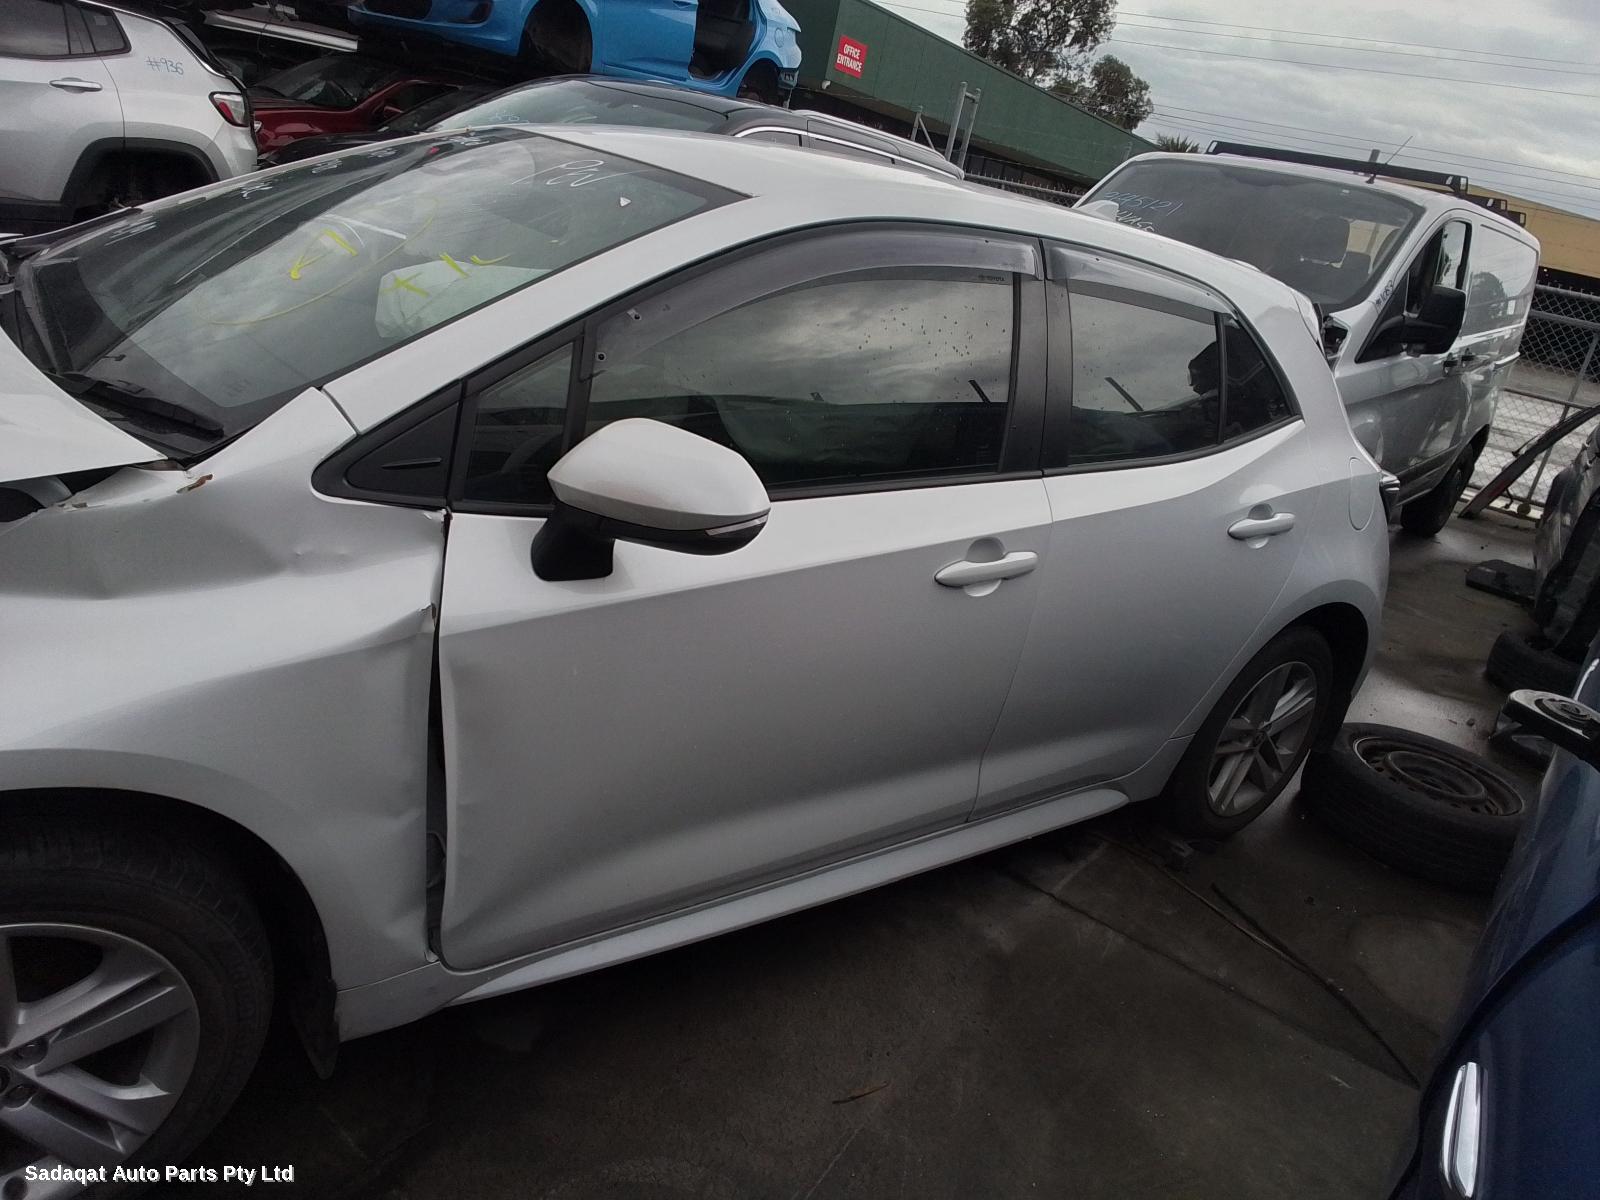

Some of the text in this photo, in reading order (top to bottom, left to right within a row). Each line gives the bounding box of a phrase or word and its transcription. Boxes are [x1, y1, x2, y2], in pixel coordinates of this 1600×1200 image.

[843, 43, 861, 60] OFFICE
[144, 56, 184, 75] #936
[836, 53, 863, 73] ENTRANCE
